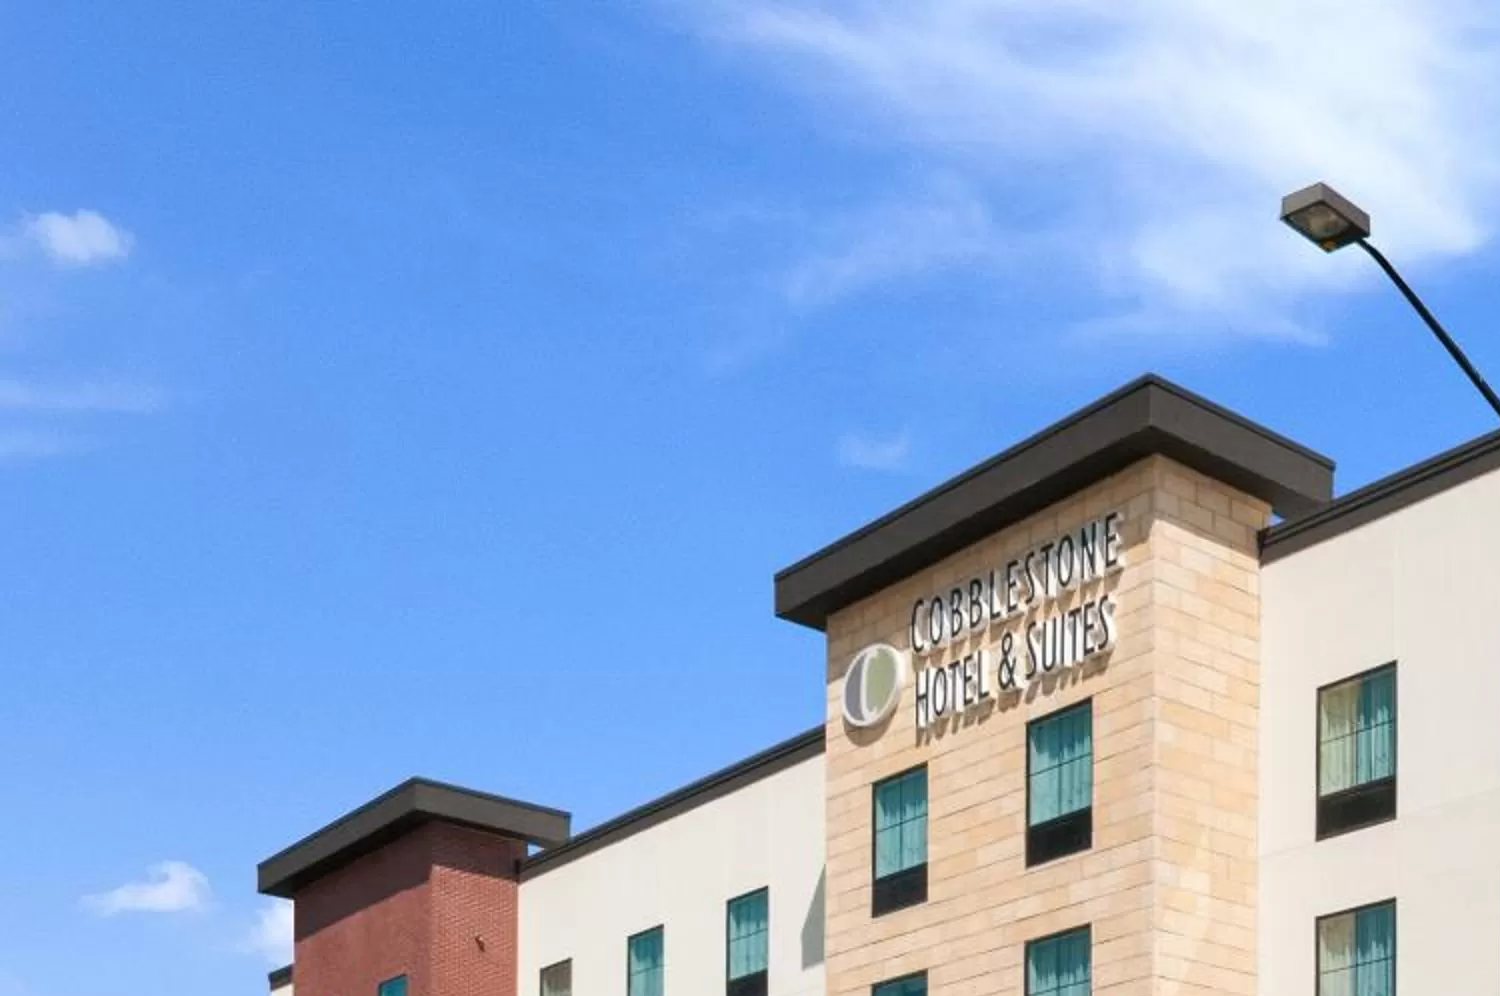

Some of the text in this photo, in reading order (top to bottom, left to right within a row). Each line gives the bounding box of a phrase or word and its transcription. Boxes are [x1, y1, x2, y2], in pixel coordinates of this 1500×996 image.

[911, 512, 1121, 653] COBBLESTONE
[915, 594, 1111, 729] HOTEL & SUITES
